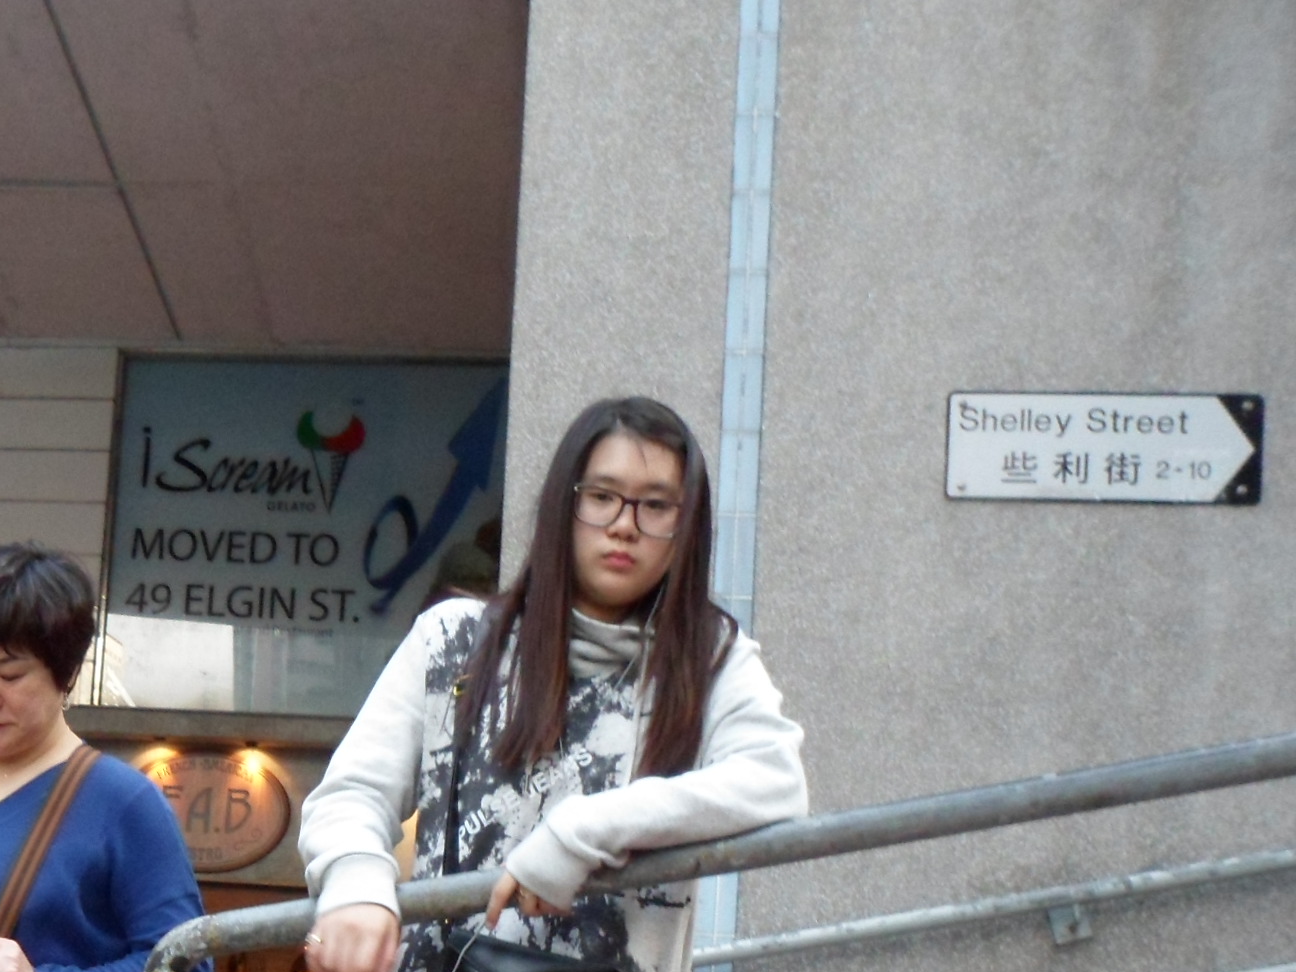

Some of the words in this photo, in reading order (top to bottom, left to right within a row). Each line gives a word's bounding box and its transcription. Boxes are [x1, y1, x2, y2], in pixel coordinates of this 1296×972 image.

[958, 407, 1072, 437] Shelley
[1086, 407, 1189, 435] Street
[1001, 452, 1141, 485] 些利街
[1155, 460, 1212, 480] 2-10
[266, 501, 316, 512] GELATO
[131, 528, 278, 564] MOVED
[287, 532, 339, 566] TO
[125, 583, 172, 614] 49
[184, 585, 296, 619] ELGIN
[309, 590, 360, 623] ST.
